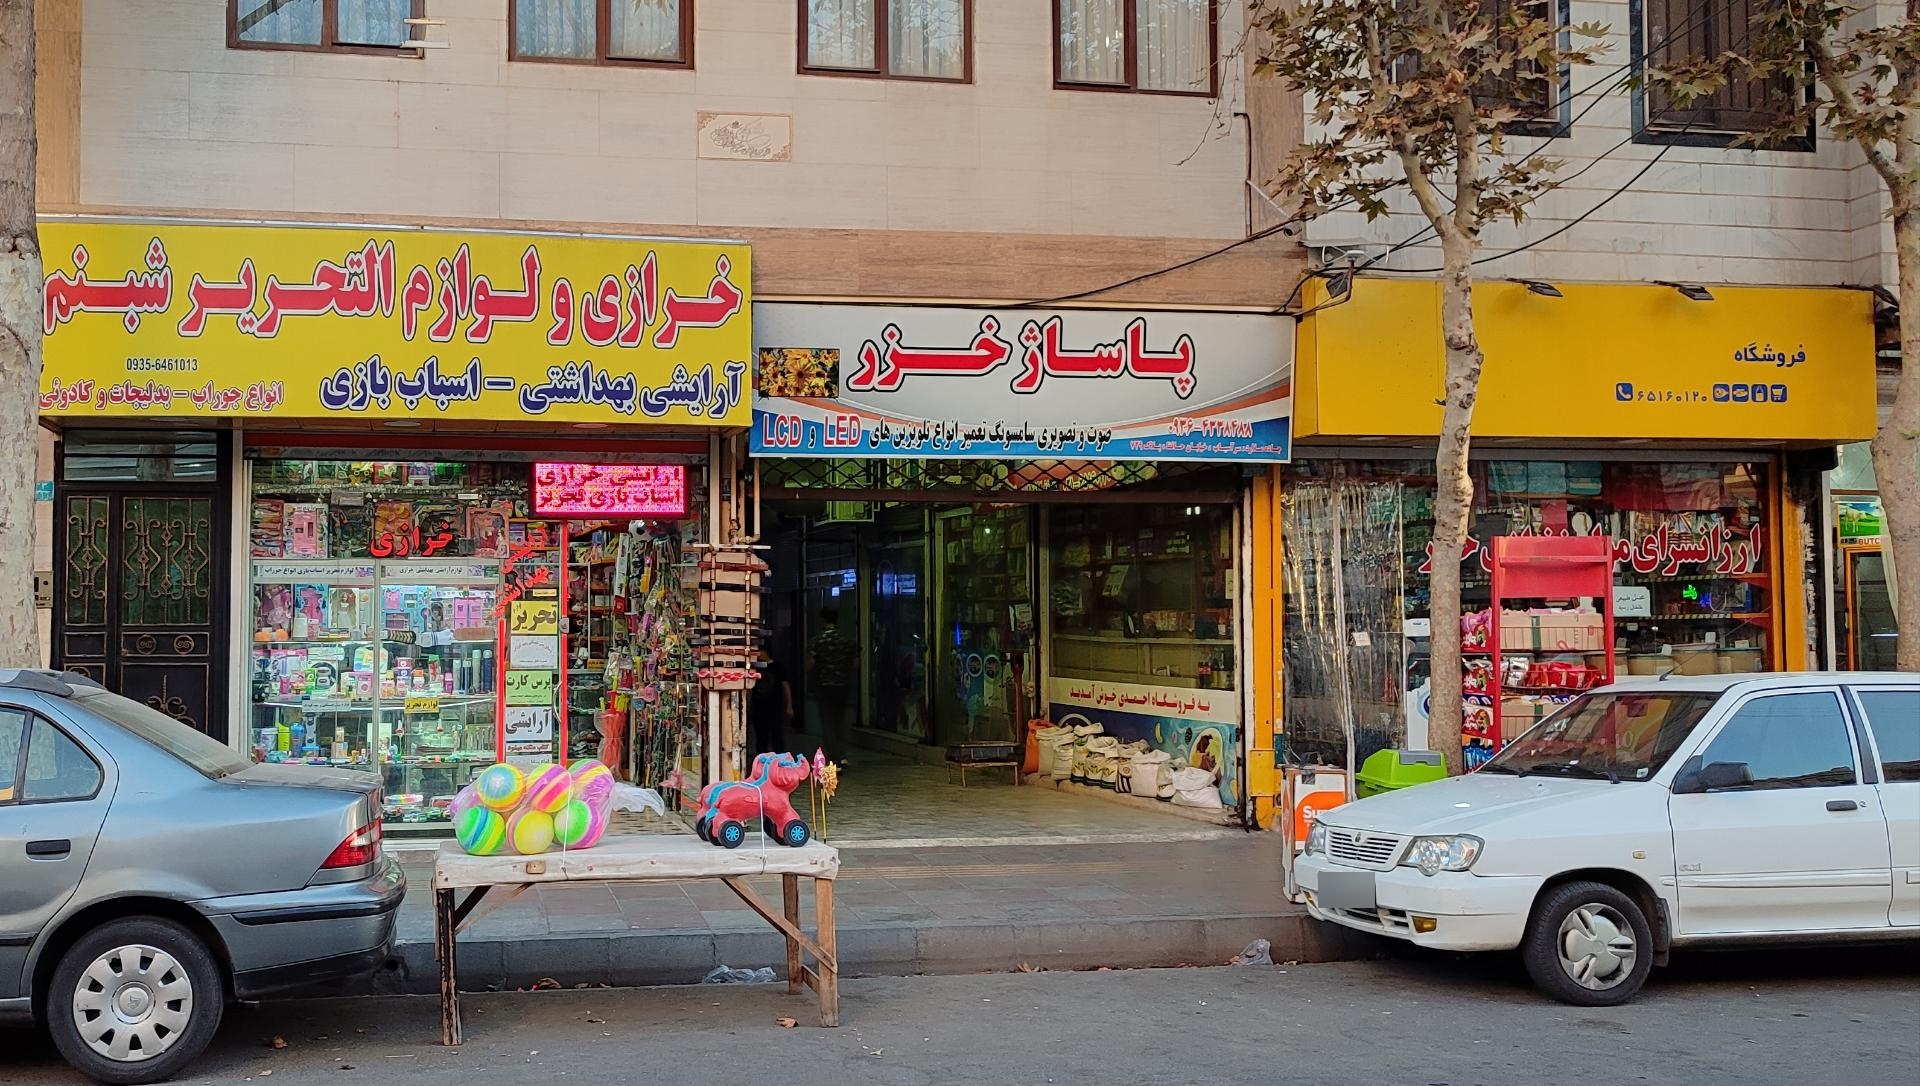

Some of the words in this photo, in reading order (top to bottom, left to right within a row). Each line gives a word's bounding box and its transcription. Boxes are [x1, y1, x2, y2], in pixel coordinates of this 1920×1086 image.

[43, 237, 173, 335] شبنم
[178, 239, 395, 337] التحریر
[402, 243, 542, 343] لوازم
[580, 250, 743, 349] خرازی
[547, 277, 574, 346] و
[126, 357, 198, 372] 0935-6461013
[846, 314, 1013, 392] خزر
[1010, 315, 1197, 400] پاساژ
[1734, 342, 1806, 367] فروشگاه
[109, 379, 172, 410] بدلیجات
[192, 381, 242, 411] جوراب
[247, 382, 284, 410] انواع
[320, 354, 392, 410] بازی
[395, 355, 481, 410] اسباب
[520, 360, 637, 415] بهداشتی
[640, 360, 746, 418] آرایشی
[1637, 389, 1708, 402] ۶۵۱۶۰۱۲۰
[96, 386, 108, 410] و
[762, 413, 804, 448] LCD
[808, 426, 817, 448] و
[823, 413, 862, 448] LED
[869, 418, 890, 448] های
[932, 420, 958, 449] انواع
[960, 421, 986, 449] تعمیر
[989, 420, 1035, 449] سامسونگ
[1037, 422, 1076, 450] تصویری
[1078, 434, 1085, 450] و
[1087, 426, 1112, 451] صوت
[371, 521, 453, 557] خرازی
[1632, 521, 1761, 576] ارزانسرای
[512, 604, 557, 631] تحریر
[507, 674, 528, 690] کارت
[531, 677, 551, 690] پرس
[1070, 684, 1095, 701] آمدید
[406, 700, 422, 710] تحریر
[423, 700, 438, 709] لوازم
[1096, 688, 1116, 705] خوش
[1119, 691, 1150, 707] احمدی
[1152, 691, 1195, 714] فروشگاه
[1198, 698, 1210, 715] به
[506, 708, 551, 734] آرایشی
